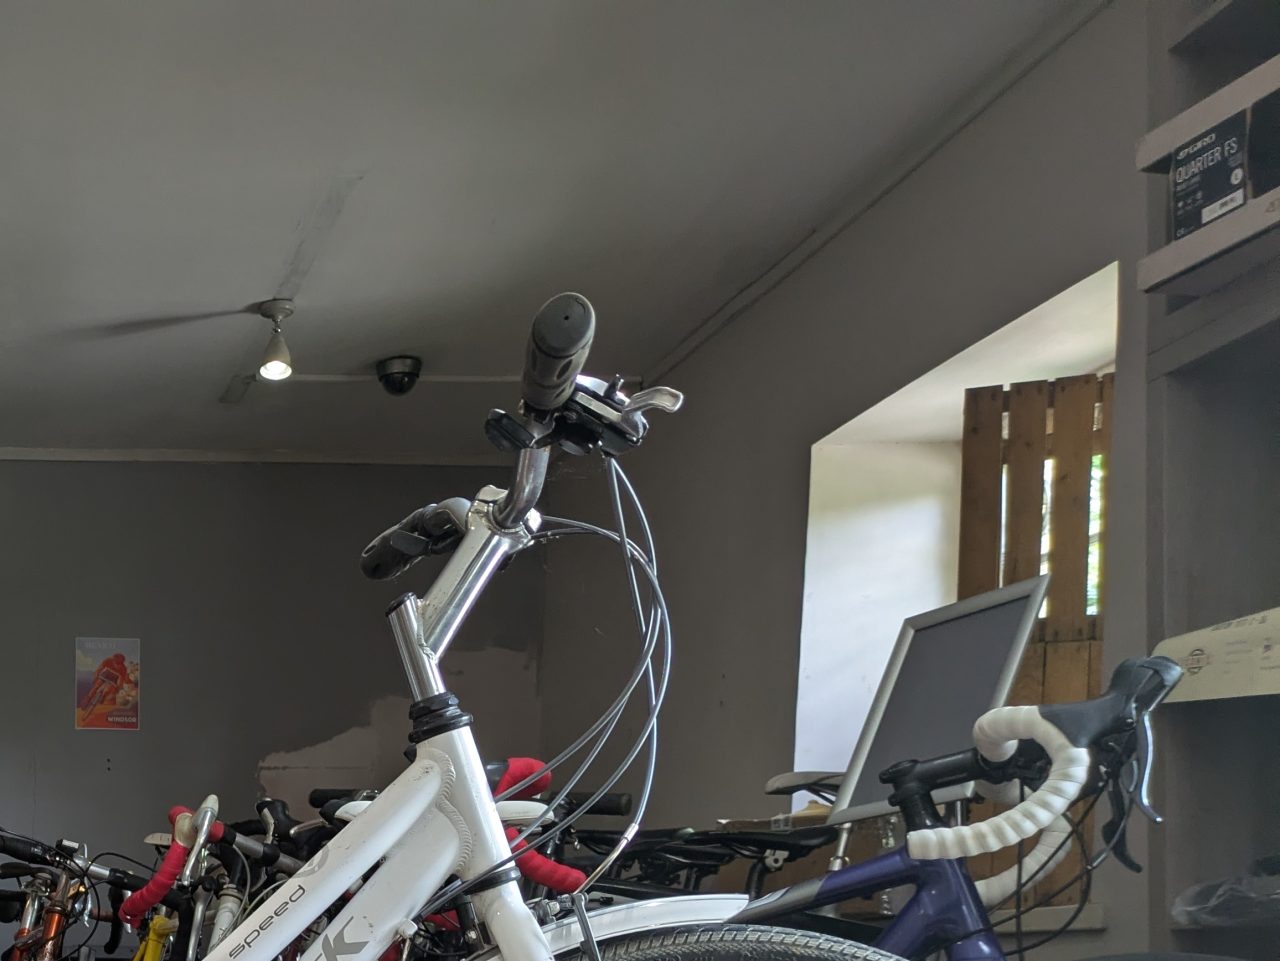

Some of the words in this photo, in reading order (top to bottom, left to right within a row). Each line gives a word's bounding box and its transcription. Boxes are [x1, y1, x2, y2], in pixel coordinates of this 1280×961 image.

[1176, 147, 1221, 183] QUARTER
[1224, 137, 1238, 158] FS
[228, 884, 306, 960] speed
